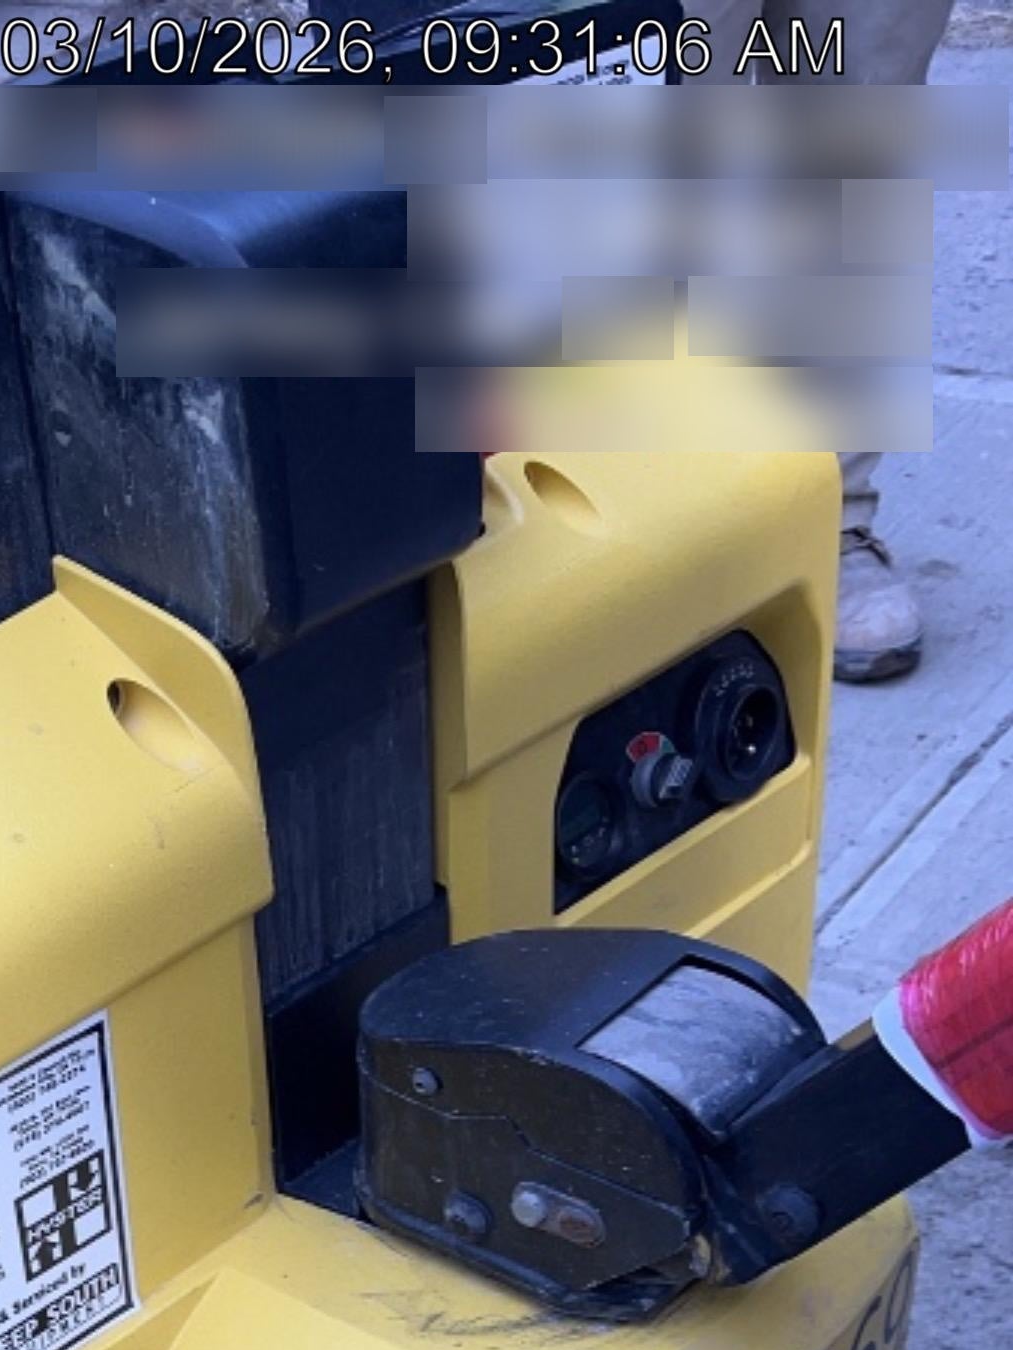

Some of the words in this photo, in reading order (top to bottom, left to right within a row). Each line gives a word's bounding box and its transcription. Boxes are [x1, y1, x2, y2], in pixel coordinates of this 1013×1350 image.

[29, 1188, 103, 1243] HYSTER
[12, 1274, 70, 1317] Serviced
[72, 1263, 87, 1288] by
[47, 1263, 122, 1326] SOUTH
